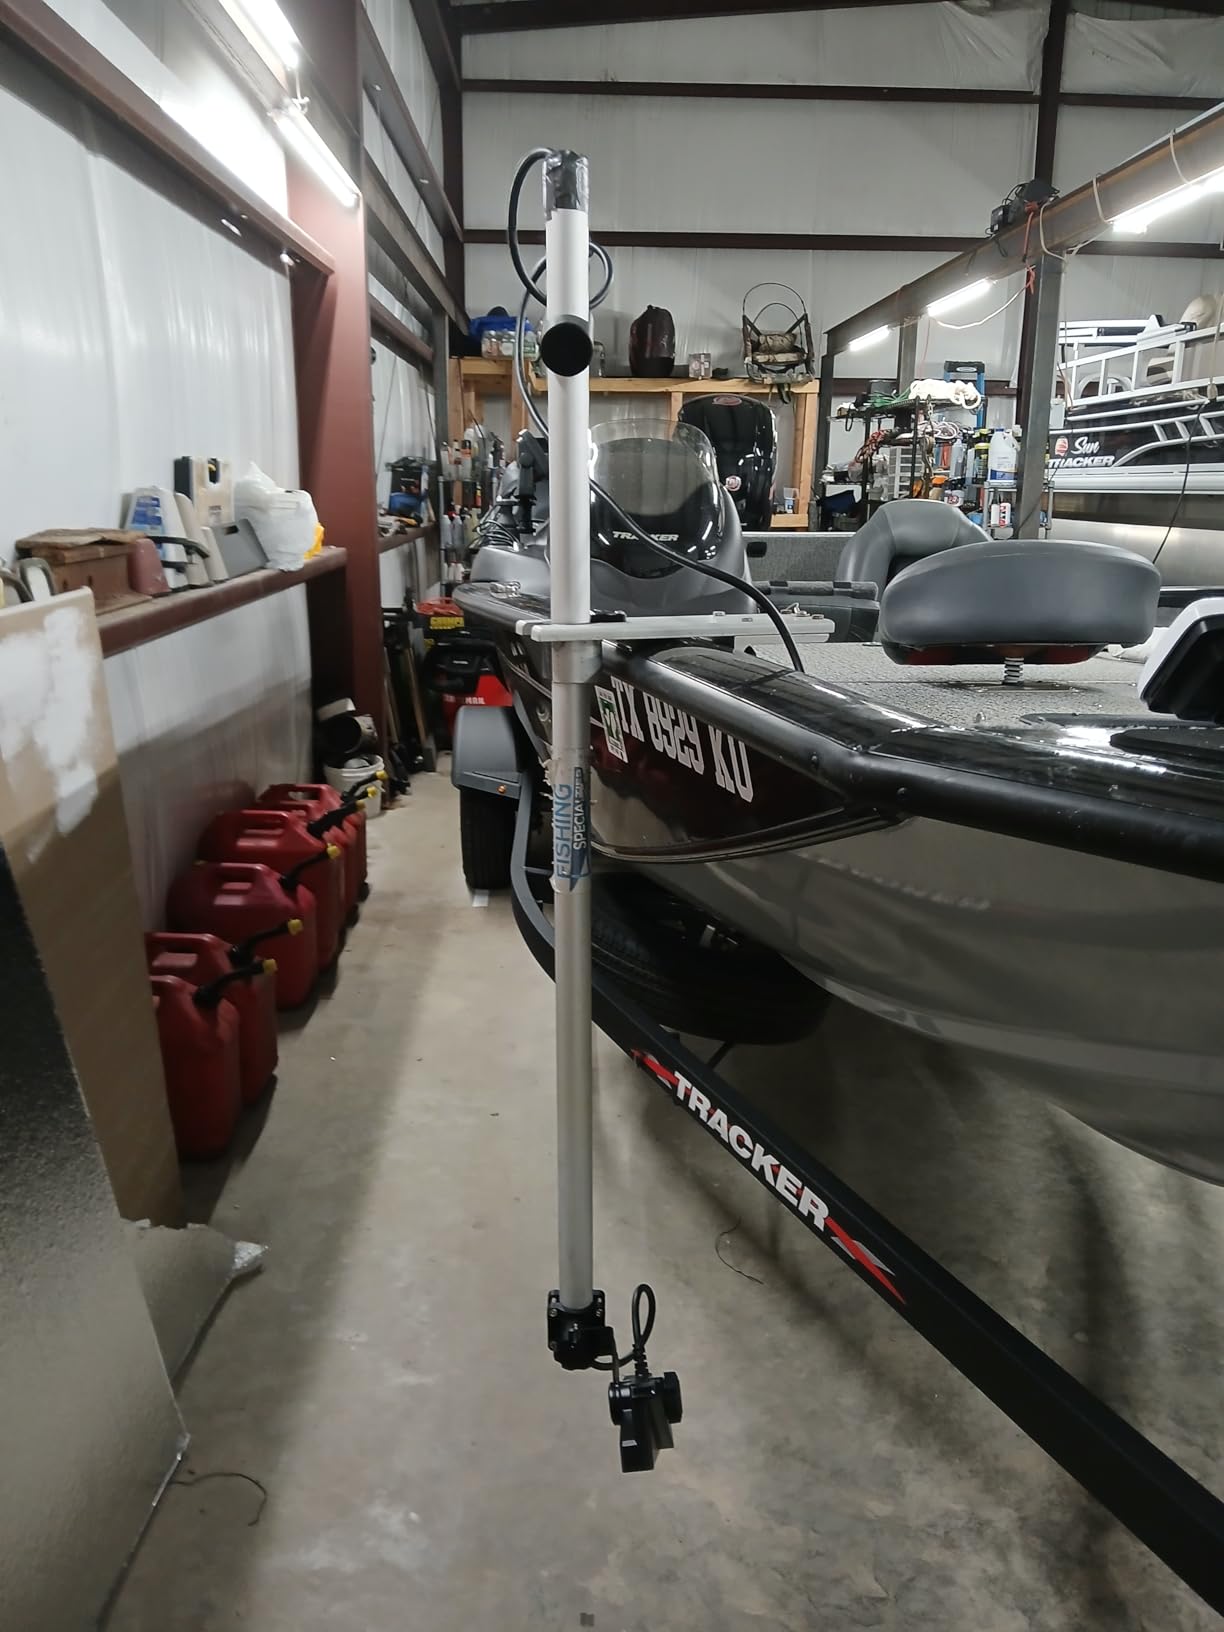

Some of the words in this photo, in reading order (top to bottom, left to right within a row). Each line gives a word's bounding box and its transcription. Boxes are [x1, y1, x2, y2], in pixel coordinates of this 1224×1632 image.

[1048, 455, 1115, 469] TRACKER
[1071, 436, 1100, 454] Sun
[612, 530, 680, 542] TRAKER
[610, 675, 645, 742] TX
[642, 691, 705, 775] 8929
[555, 783, 573, 879] FISHING
[674, 1070, 829, 1232] TRACKER
